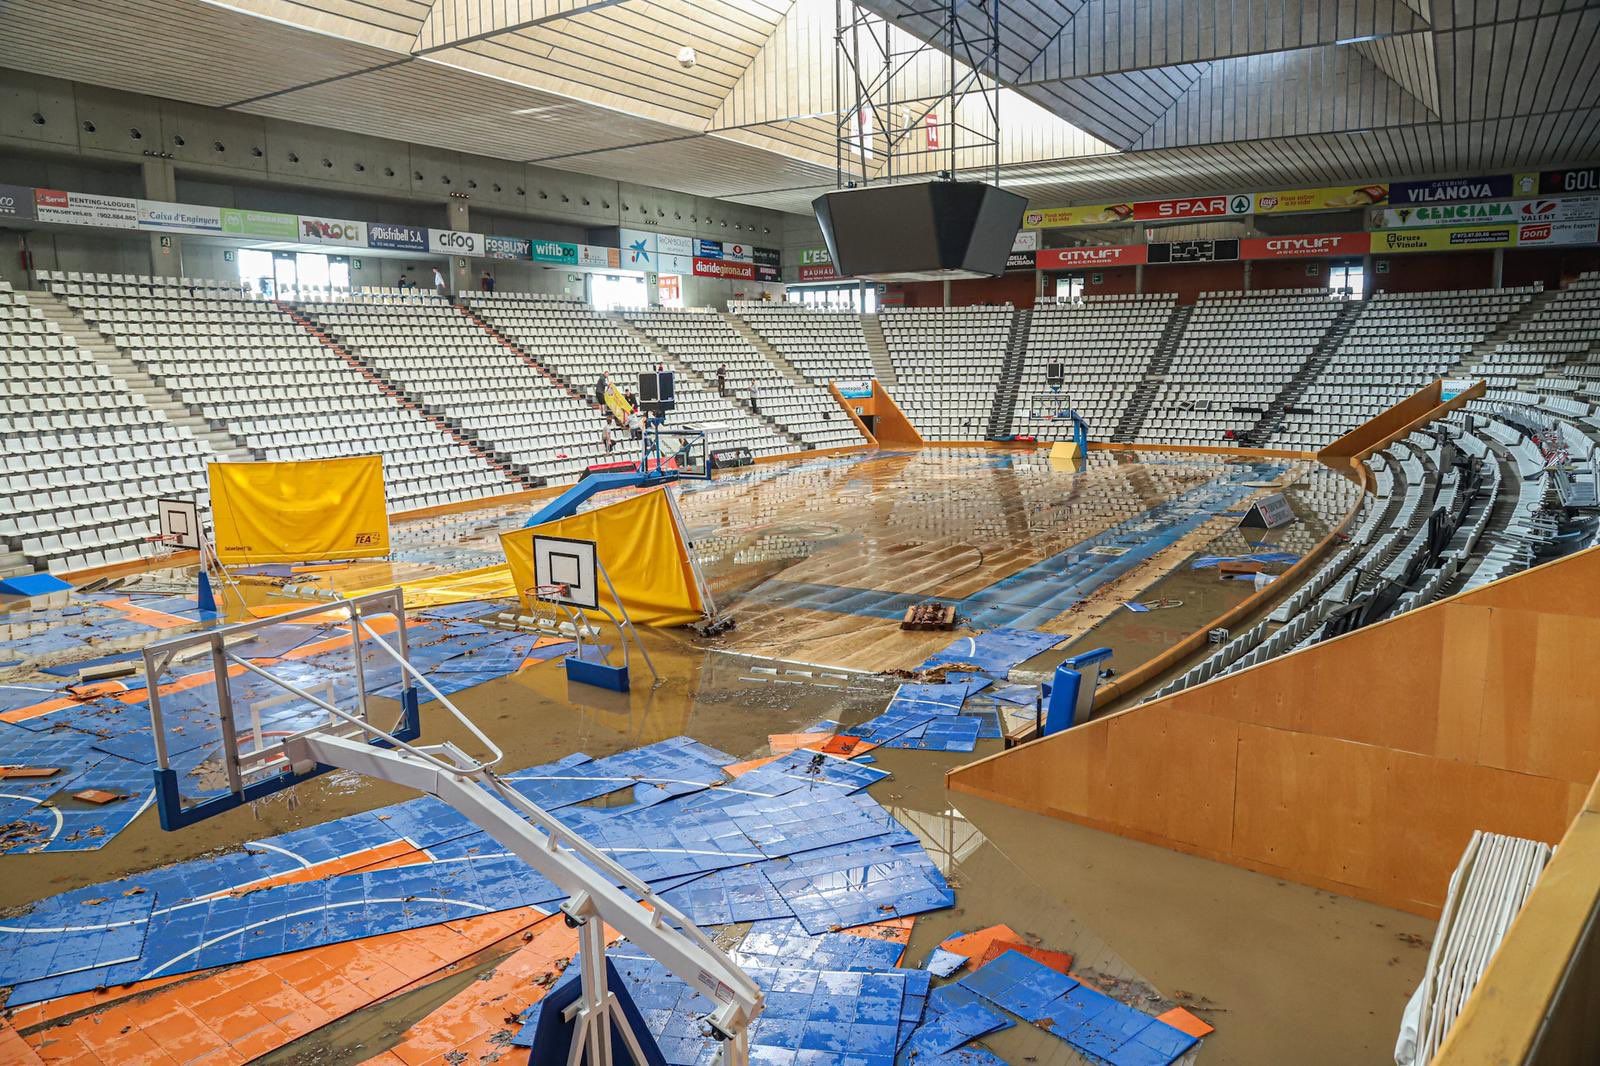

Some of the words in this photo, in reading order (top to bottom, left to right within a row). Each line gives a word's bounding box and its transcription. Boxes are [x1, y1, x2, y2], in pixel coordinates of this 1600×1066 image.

[1565, 170, 1600, 191] GOL
[1408, 184, 1492, 201] VILANOVA
[69, 197, 136, 208] RENTING-LLOGUER
[1159, 199, 1225, 216] SPAR
[150, 211, 172, 220] Caixa
[174, 212, 219, 225] d'Enginyers
[1416, 204, 1513, 219] GENCIANA
[1522, 229, 1548, 239] pont
[439, 232, 474, 251] cifog
[486, 240, 529, 255] FOSBURY
[1267, 237, 1342, 250] CITYLIFT
[536, 243, 575, 257] wifiboo
[1058, 249, 1122, 261] CITYLIFT
[695, 260, 752, 277] diaridegirona.cat
[804, 268, 834, 277] BAUHAU
